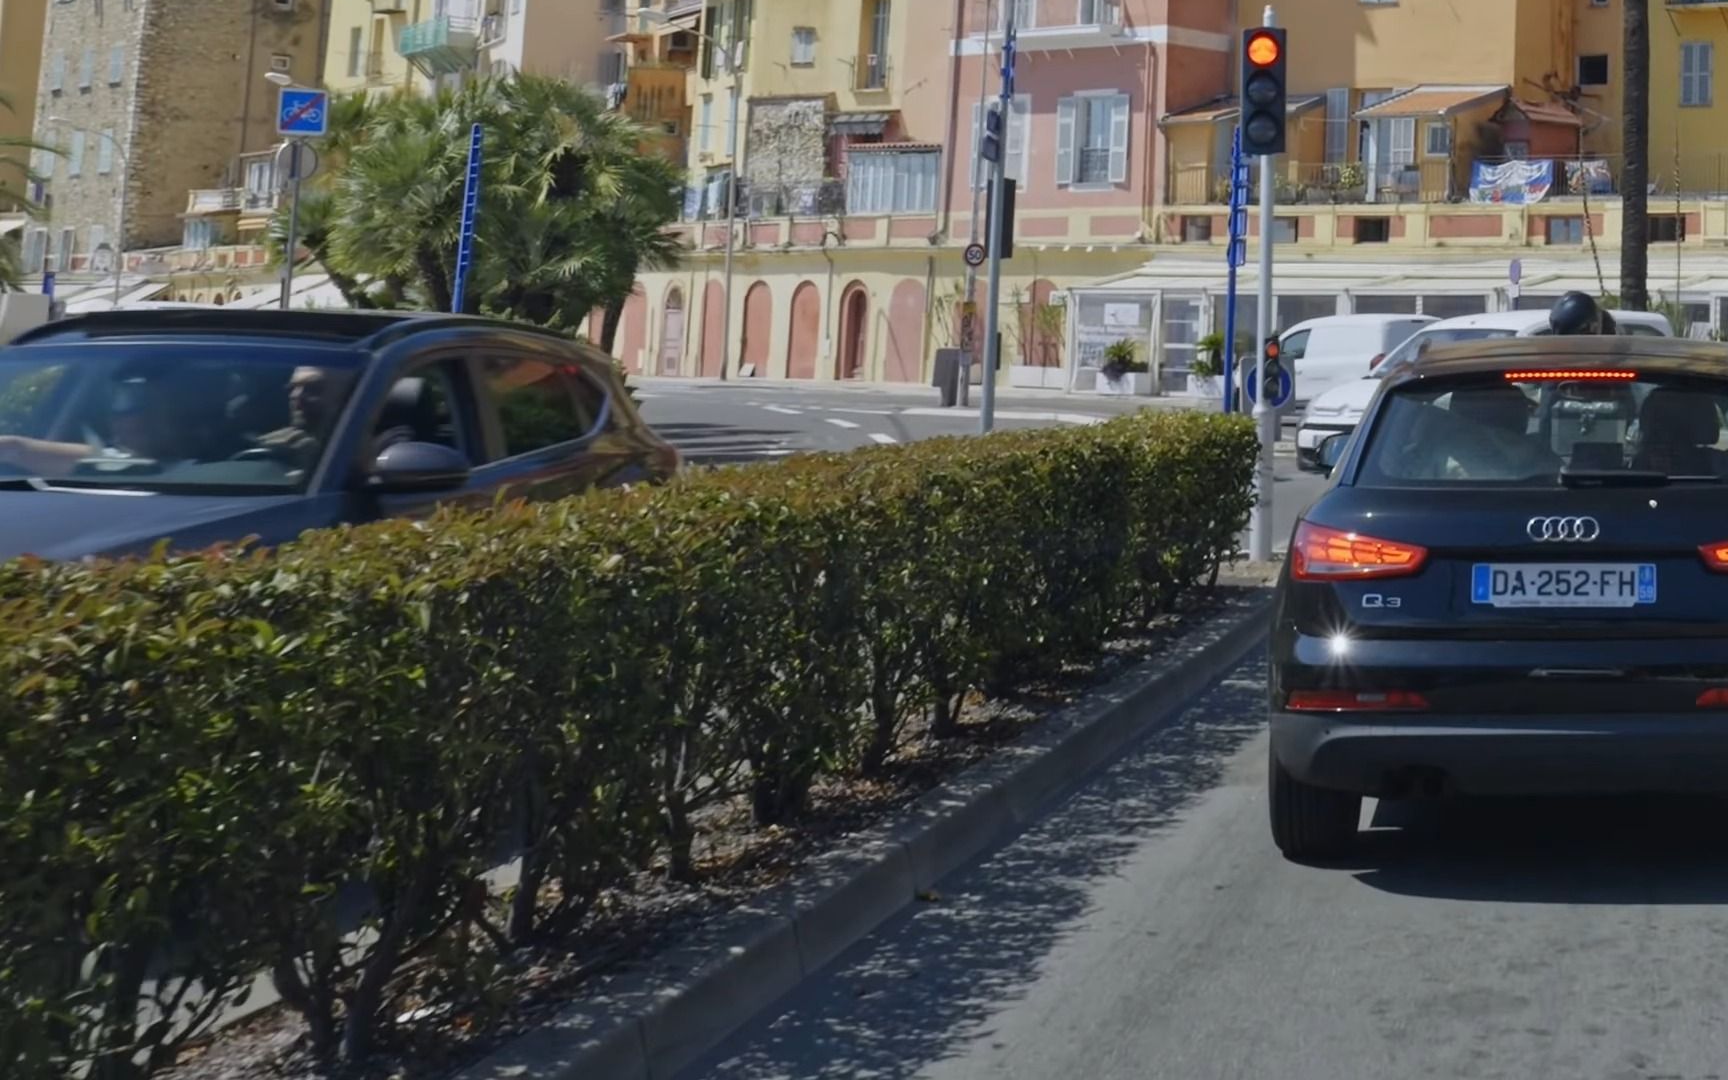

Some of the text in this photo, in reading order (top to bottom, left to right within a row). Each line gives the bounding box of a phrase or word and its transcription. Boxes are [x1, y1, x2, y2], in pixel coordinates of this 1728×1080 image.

[968, 249, 981, 260] 50
[1492, 569, 1636, 597] DA-252-FH
[1361, 593, 1402, 608] Q3
